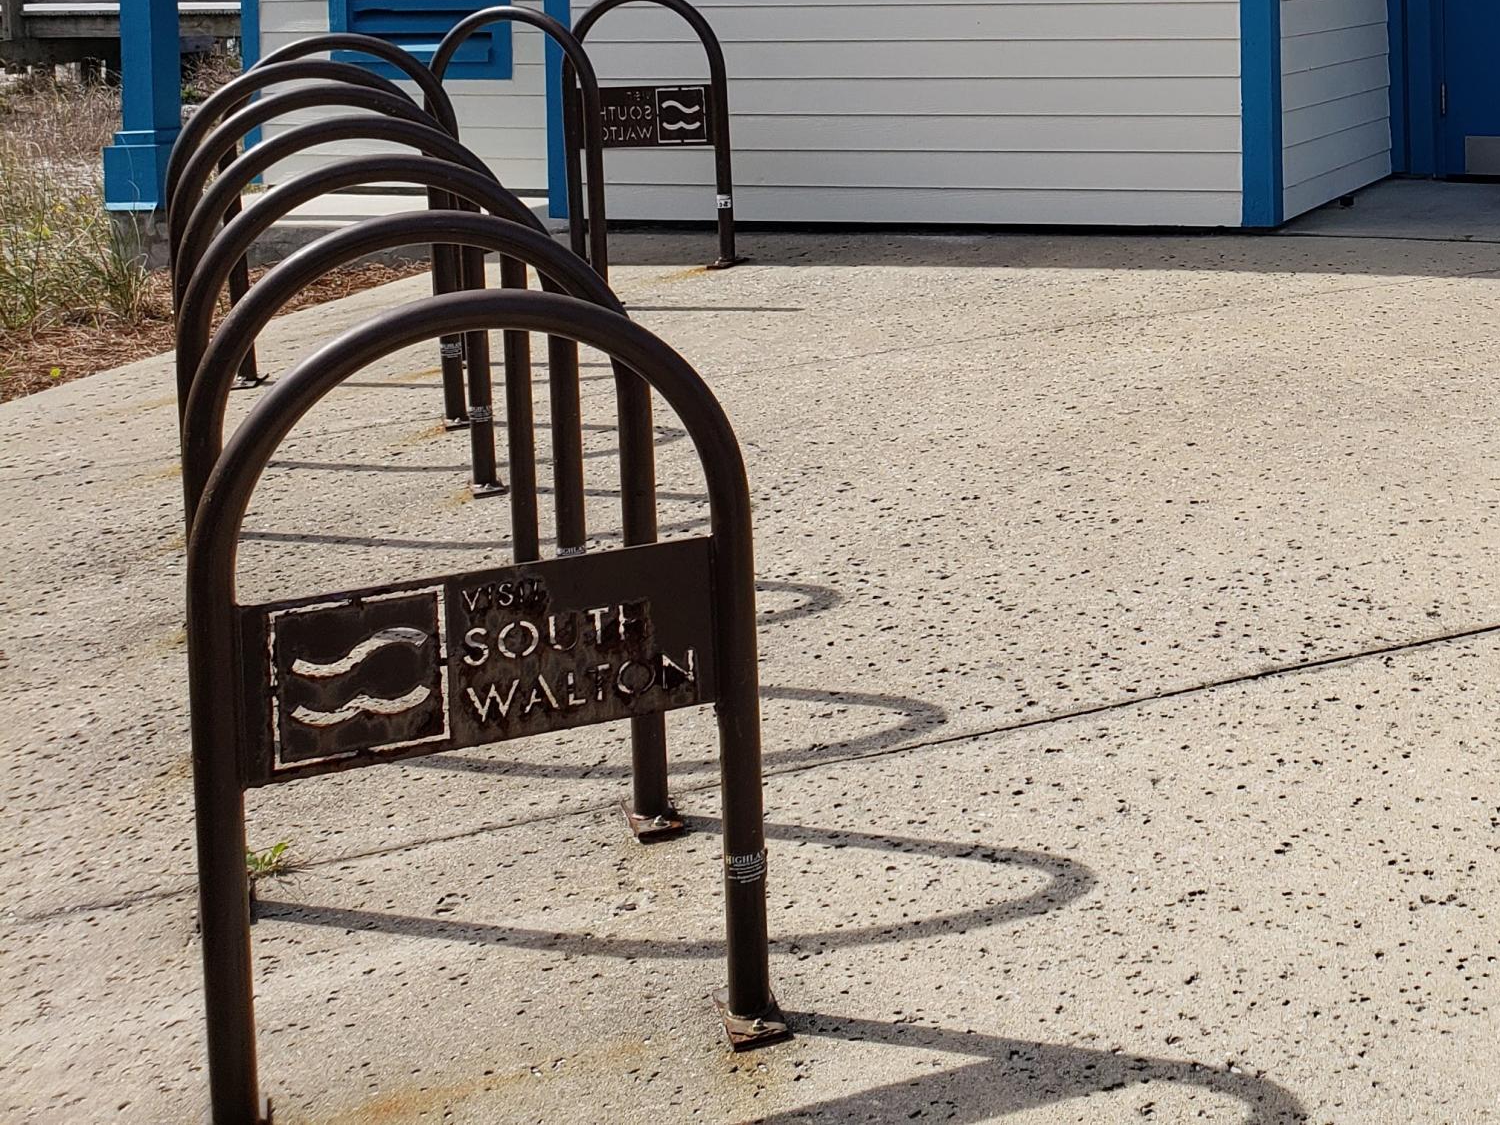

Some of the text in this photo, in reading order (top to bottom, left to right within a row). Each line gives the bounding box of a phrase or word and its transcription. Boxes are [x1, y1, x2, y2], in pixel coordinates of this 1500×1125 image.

[462, 578, 543, 612] VISIT
[463, 604, 648, 667] SOUTH
[466, 649, 697, 723] WALTON
